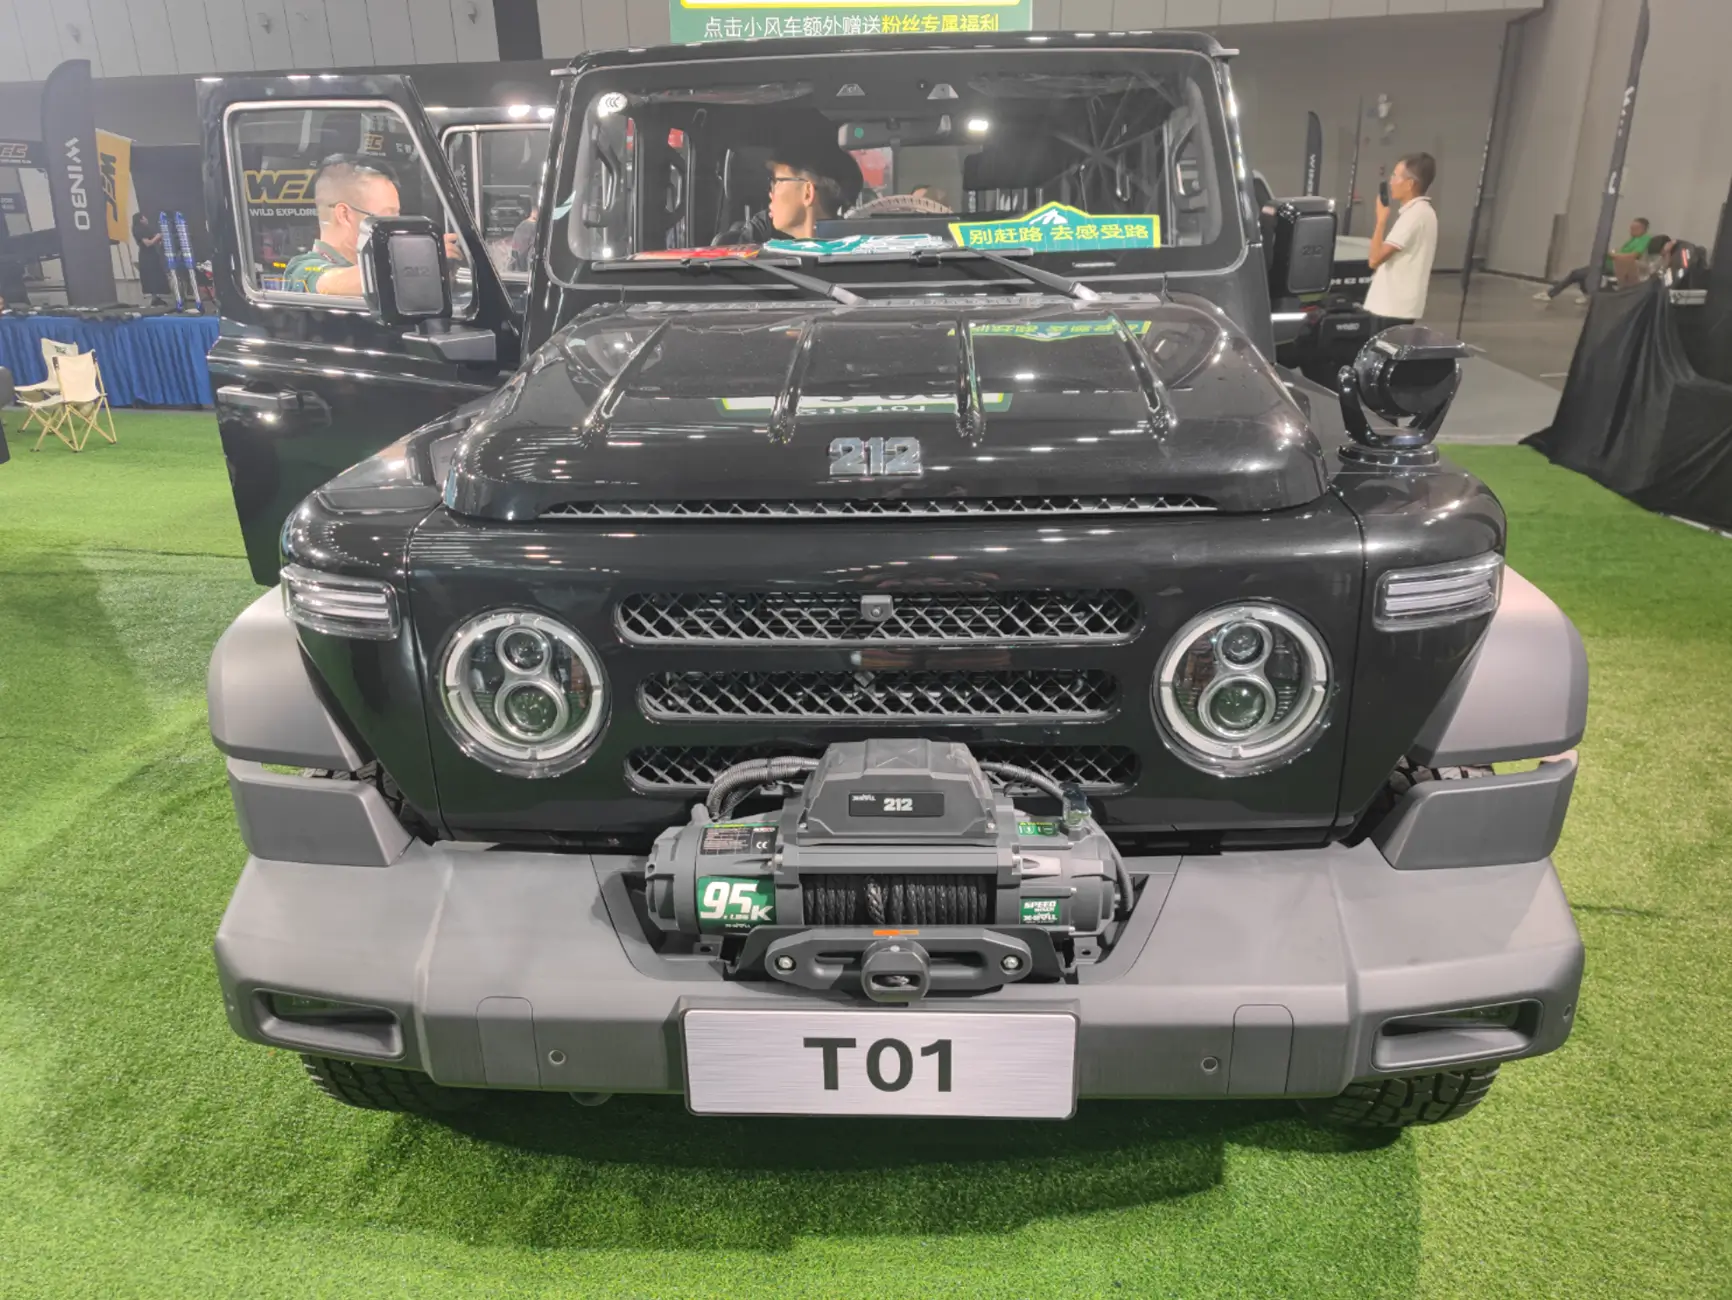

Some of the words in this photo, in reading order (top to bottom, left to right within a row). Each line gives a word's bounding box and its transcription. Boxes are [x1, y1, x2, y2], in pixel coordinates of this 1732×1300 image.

[704, 14, 998, 38] 点击小风车额外赠送粉丝专属福利
[250, 208, 274, 216] WILD
[970, 227, 1043, 245] 别赶路
[1050, 223, 1149, 241] 去感受路
[828, 436, 923, 477] 212
[883, 797, 913, 811] 212
[803, 1037, 953, 1092] T01
